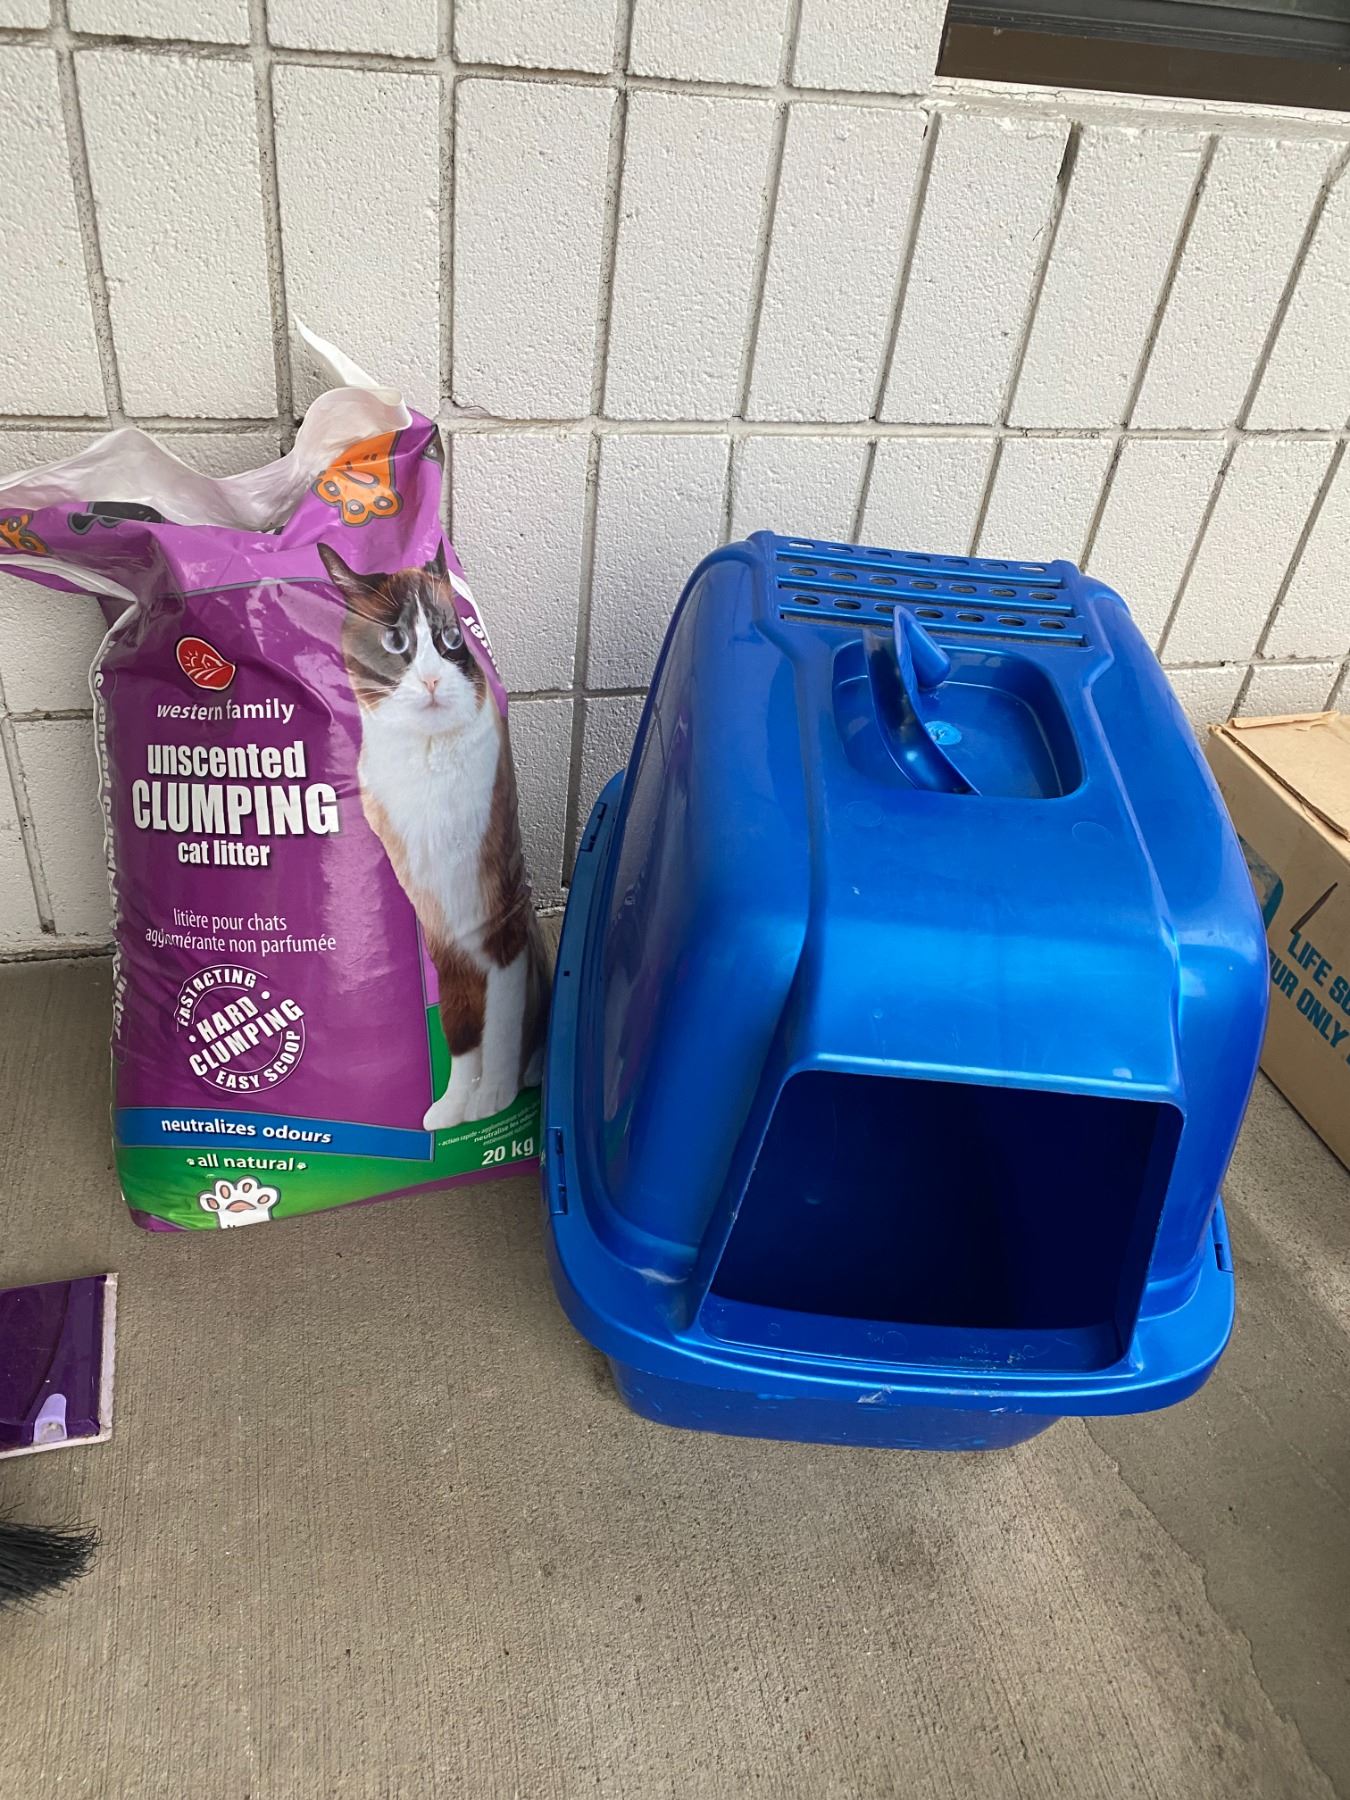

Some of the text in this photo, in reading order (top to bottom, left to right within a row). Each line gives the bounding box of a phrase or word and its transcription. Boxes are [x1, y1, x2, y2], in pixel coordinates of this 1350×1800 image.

[156, 697, 295, 724] western family
[147, 740, 307, 779] unscented
[132, 779, 341, 836] CLUMPING
[177, 839, 271, 867] cat litter
[173, 907, 288, 934] litière pour chats
[229, 938, 257, 953] non
[261, 933, 337, 957] parfumée
[1287, 930, 1333, 988] LIFE
[177, 968, 257, 1027] FAST ACTING
[188, 998, 305, 1077] CLUMPING
[196, 995, 260, 1044] HARD
[1296, 987, 1350, 1049] ONLY
[215, 1030, 301, 1090] EASY SCOOP
[161, 1118, 333, 1143] neutralizes odours
[197, 1153, 294, 1171] all natural
[481, 1145, 506, 1165] 20
[511, 1136, 534, 1157] kg
